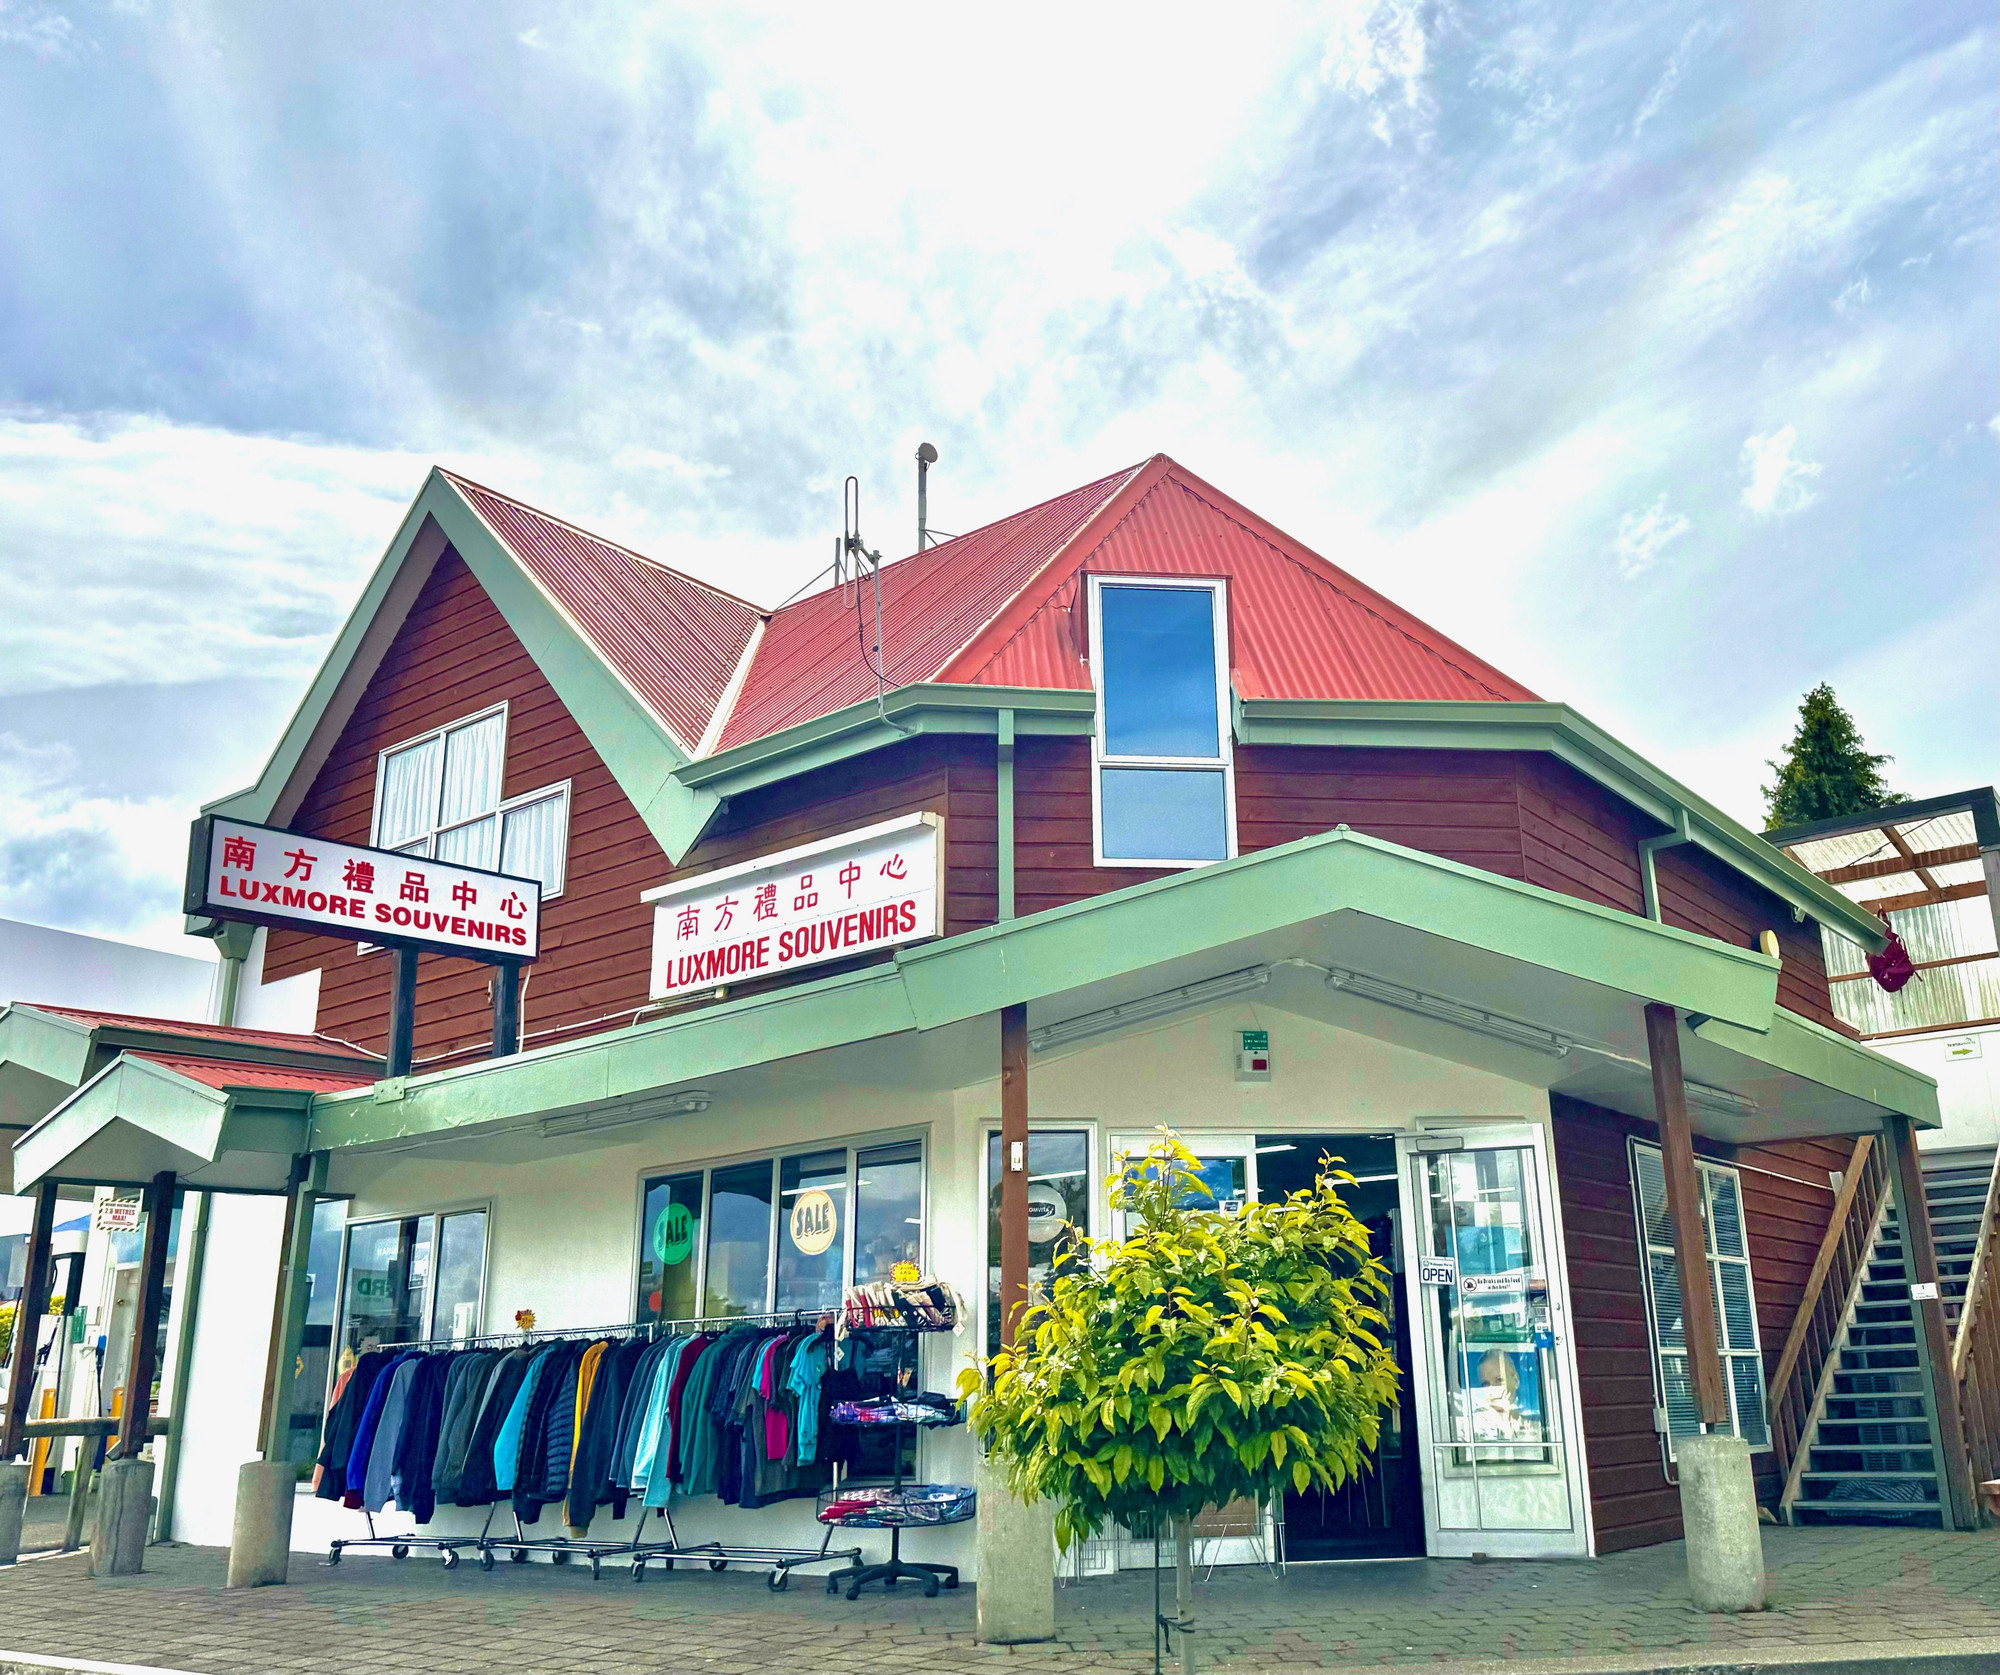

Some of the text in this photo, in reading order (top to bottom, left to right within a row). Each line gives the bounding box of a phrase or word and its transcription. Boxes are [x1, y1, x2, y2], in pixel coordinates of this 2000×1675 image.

[219, 875, 528, 946] LUXMORE SOUVENIRS
[223, 836, 528, 920] 南方禮品中心
[676, 853, 908, 941] 南方禮品中心
[666, 899, 917, 989] LUXMORE SOUVENIRS
[658, 1214, 688, 1251] SALE
[795, 1201, 831, 1240] SALE
[1423, 1268, 1453, 1283] OPEN
